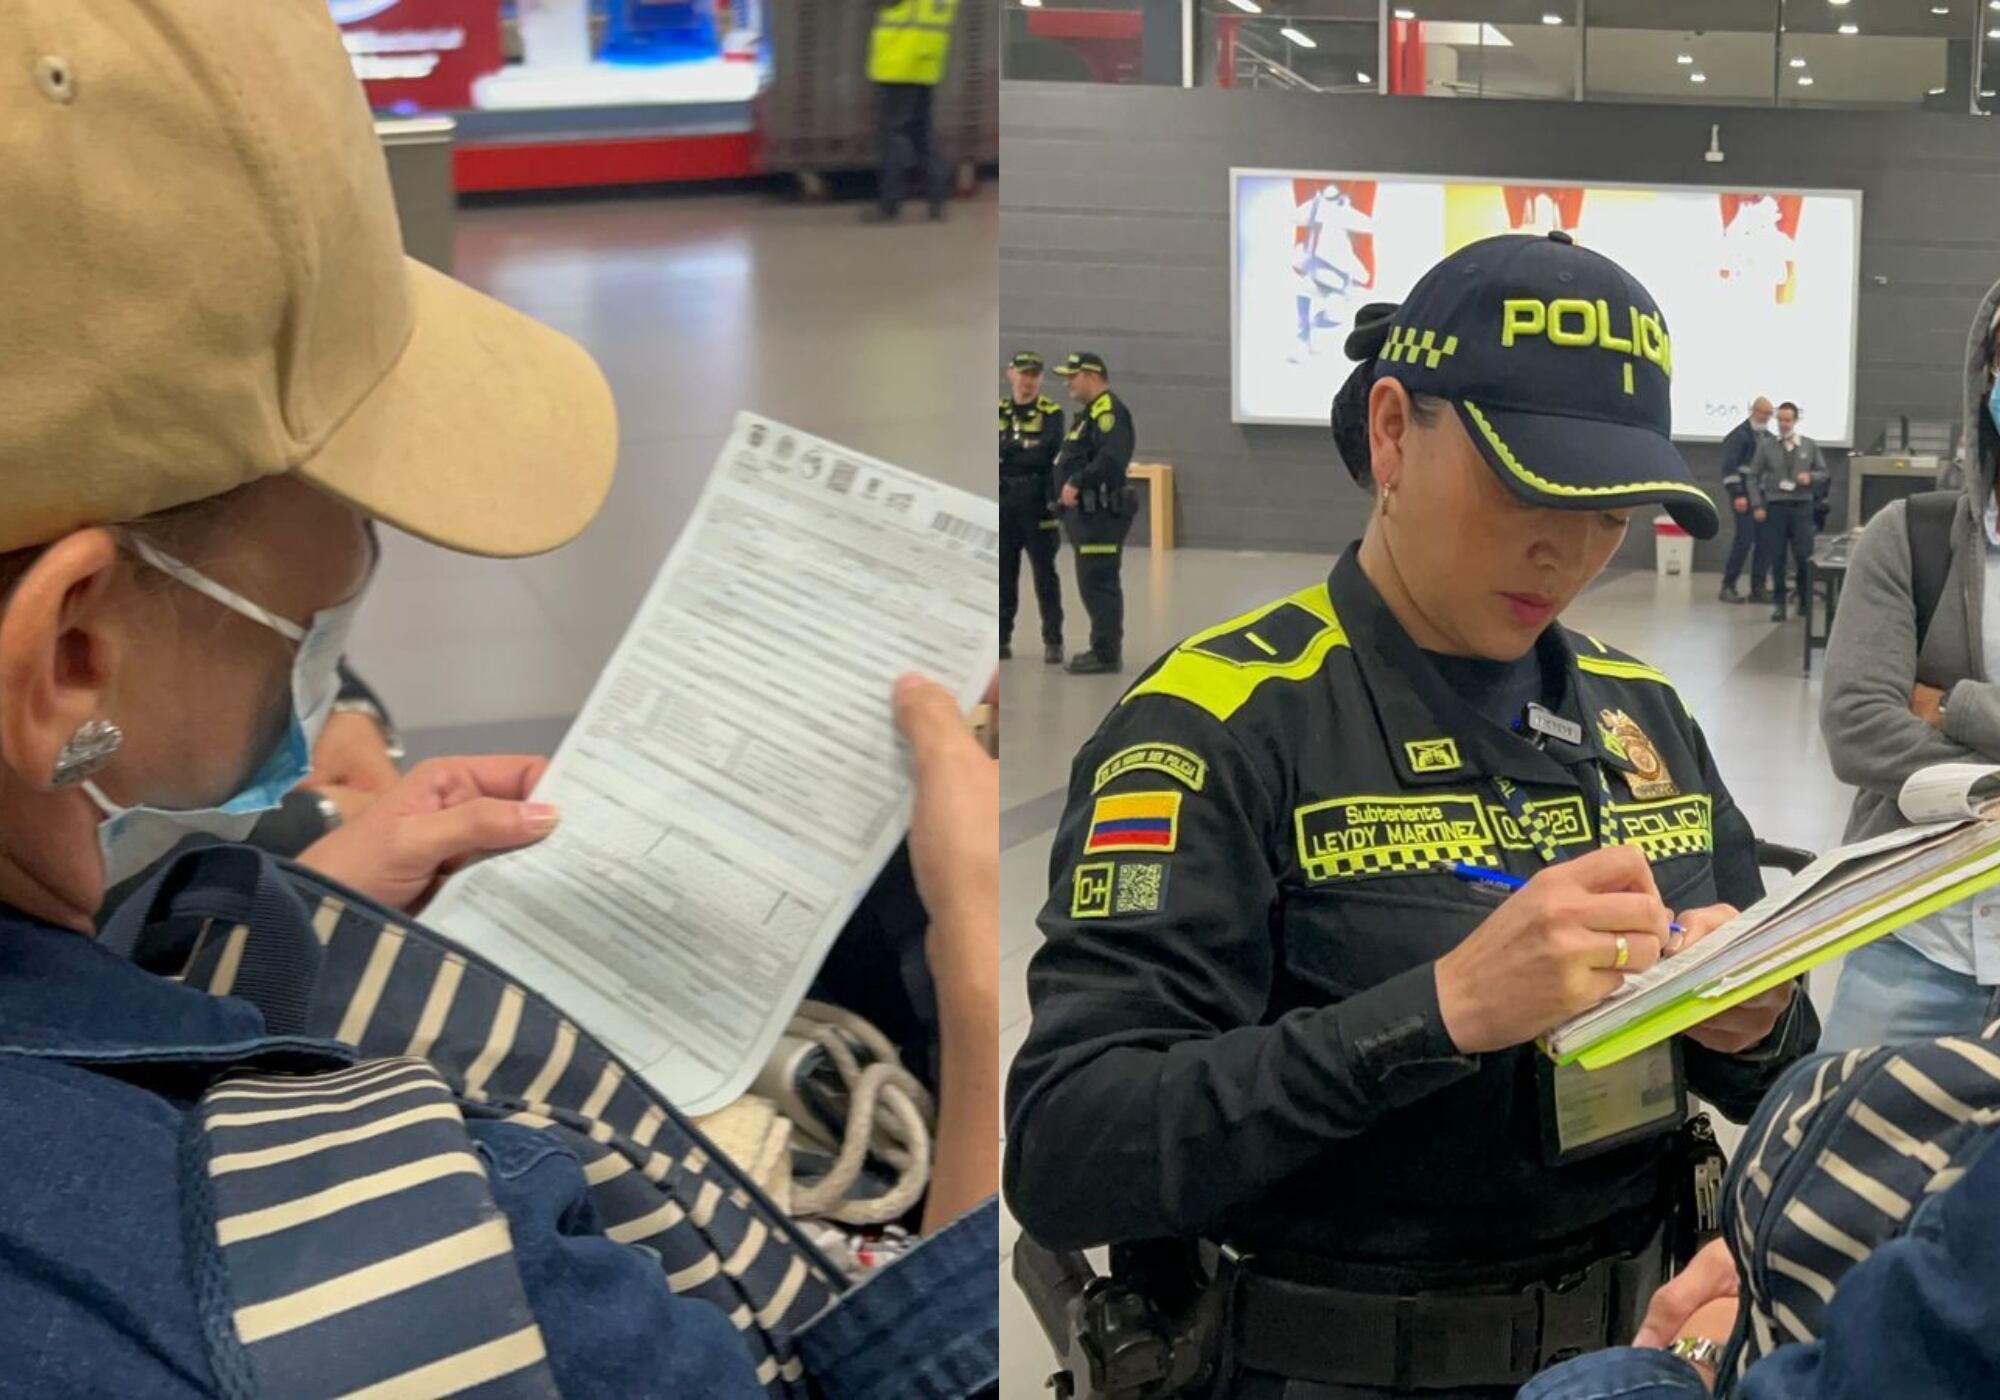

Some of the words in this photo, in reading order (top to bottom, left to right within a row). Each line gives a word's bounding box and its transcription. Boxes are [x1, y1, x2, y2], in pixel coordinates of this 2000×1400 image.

[1345, 804, 1443, 825] Subteniente
[1313, 823, 1376, 855] LEYDY
[1386, 820, 1480, 846] MARTINEZ
